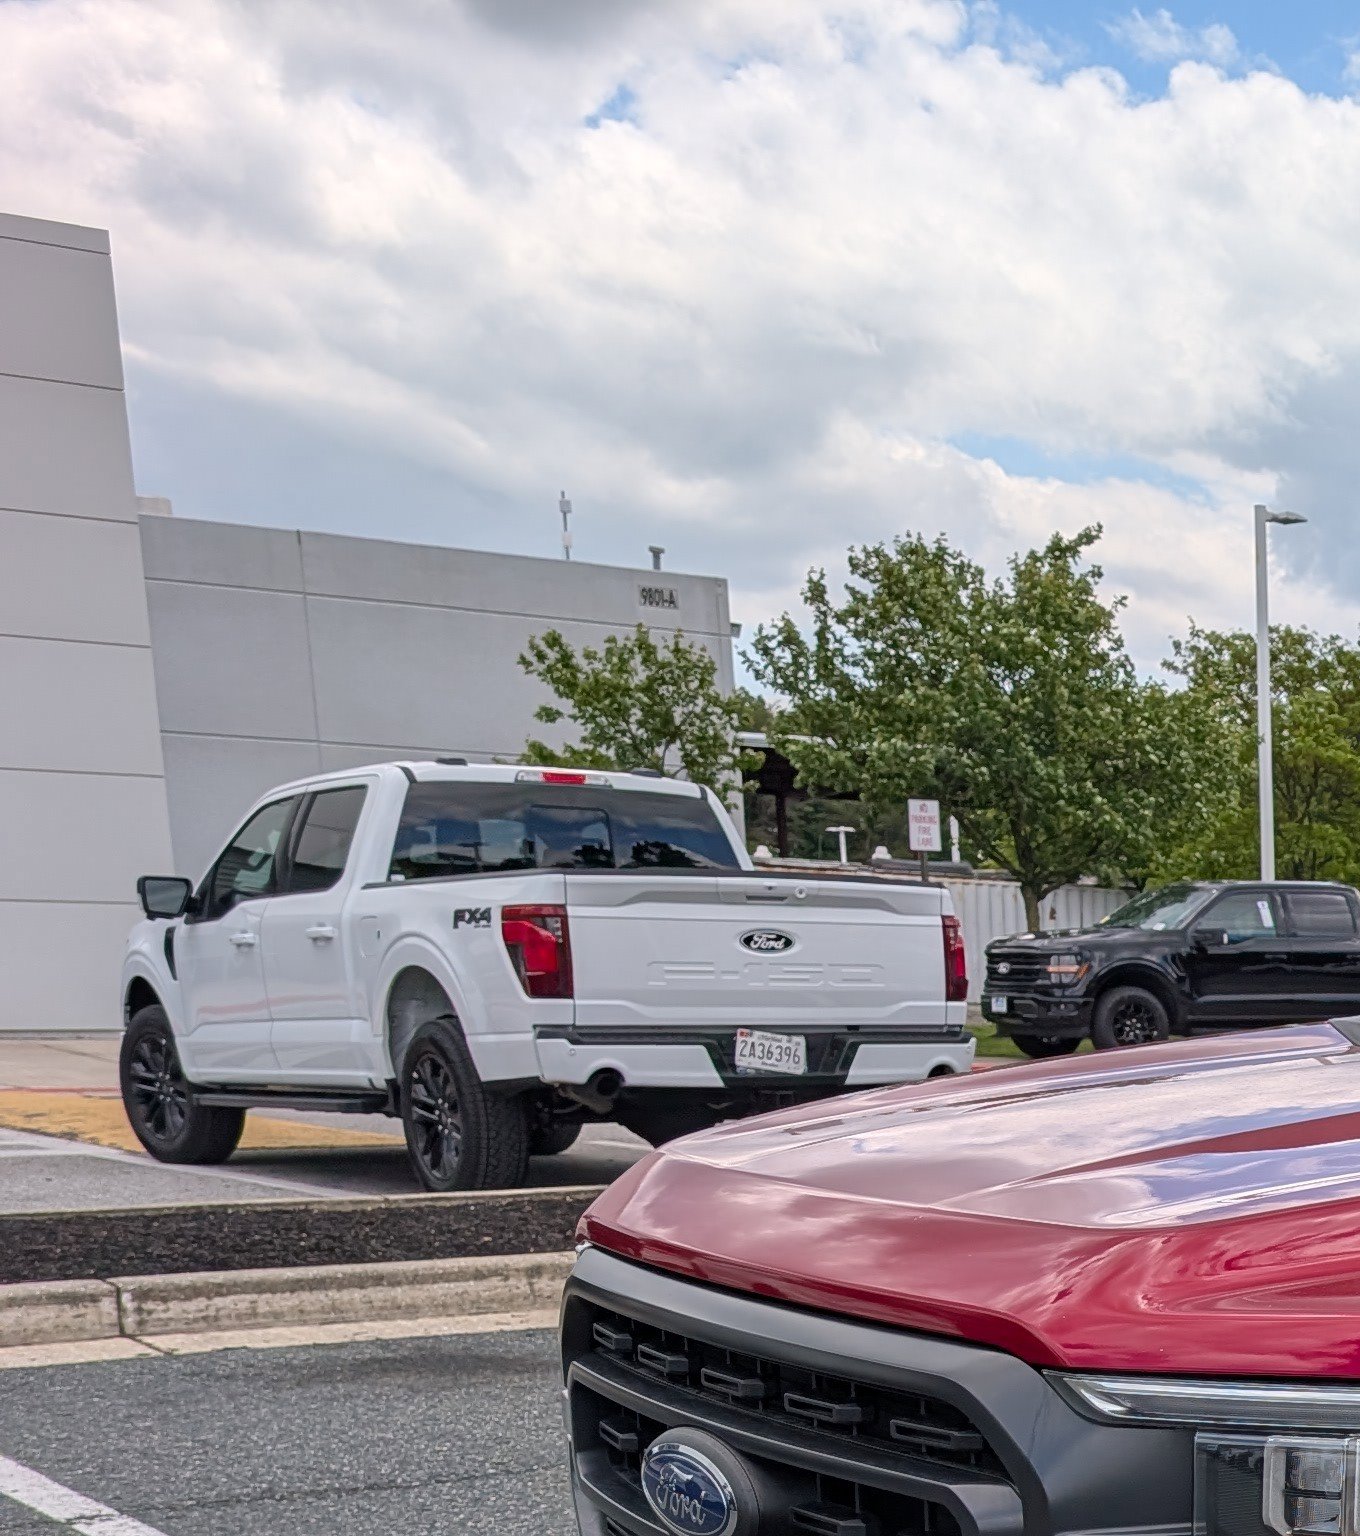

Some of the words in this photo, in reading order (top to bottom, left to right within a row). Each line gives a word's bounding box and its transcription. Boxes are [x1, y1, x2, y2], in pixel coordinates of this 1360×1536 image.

[453, 907, 492, 929] FX4
[750, 932, 786, 950] Ford
[739, 1039, 801, 1065] 2A36396
[655, 1462, 707, 1526] Ford
